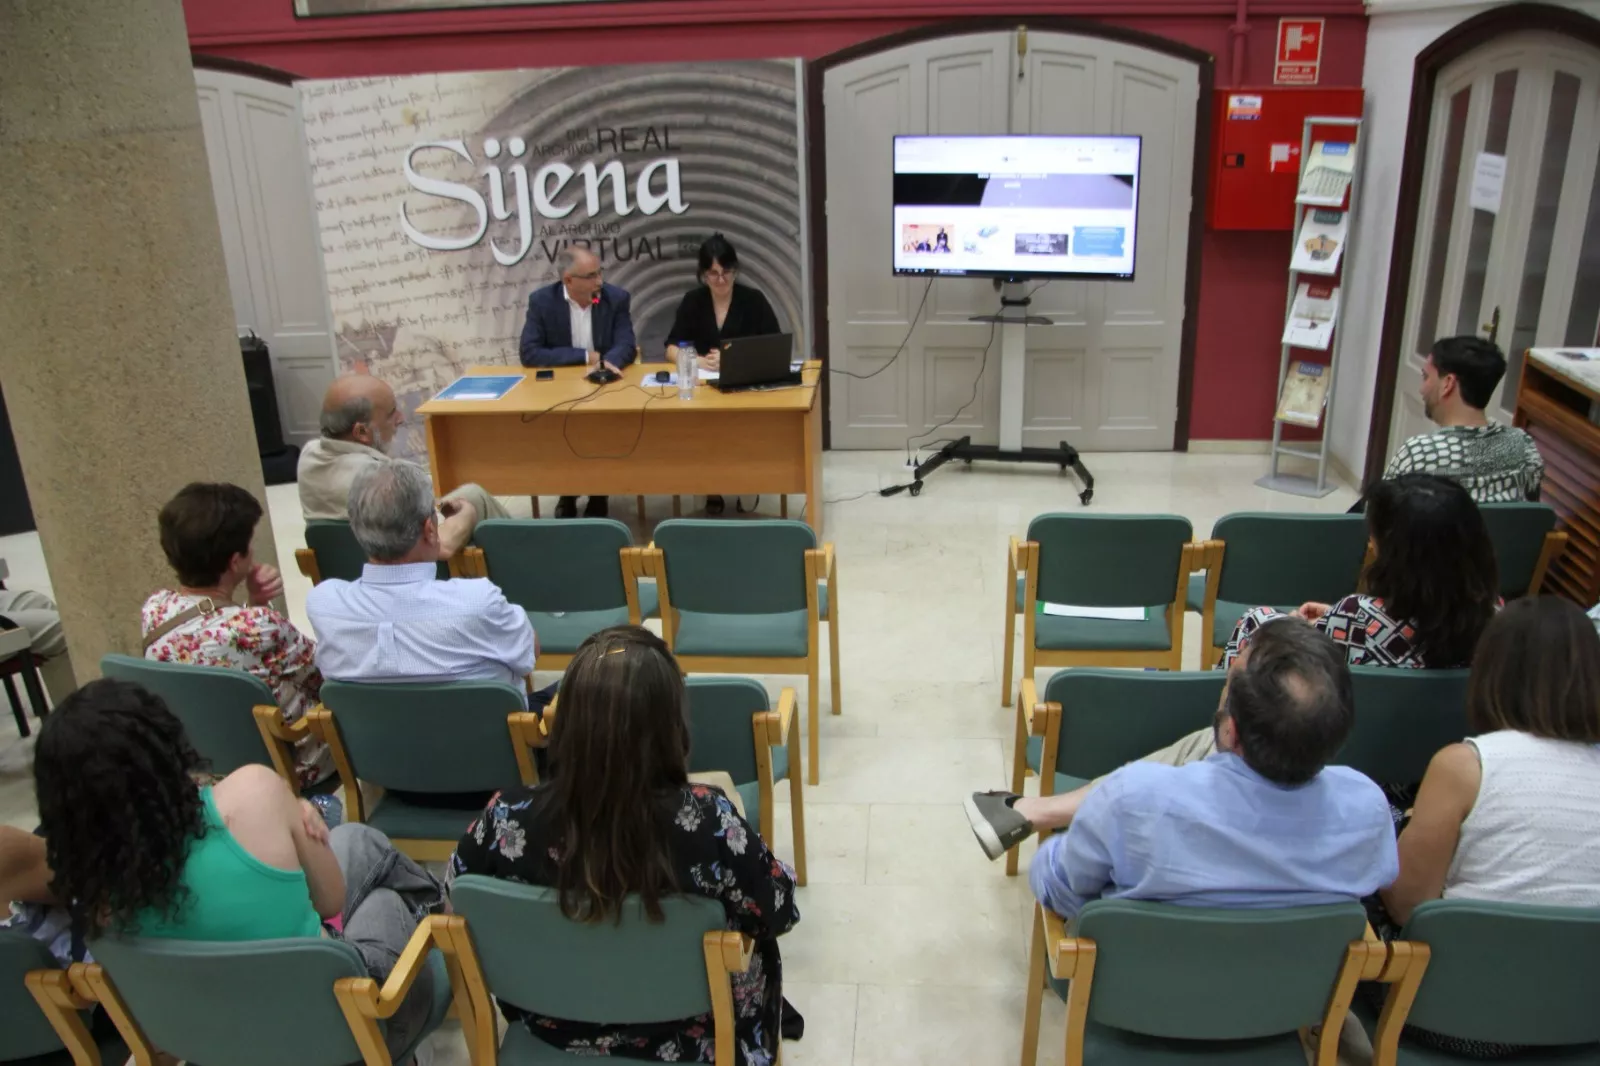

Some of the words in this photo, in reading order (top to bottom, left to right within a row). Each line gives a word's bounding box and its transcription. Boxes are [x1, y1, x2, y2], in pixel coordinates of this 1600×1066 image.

[532, 141, 596, 157] ARCHIVO
[597, 125, 681, 152] REAL
[399, 136, 690, 266] Sijena
[539, 225, 557, 236] AL
[560, 222, 621, 236] ARCHIVO
